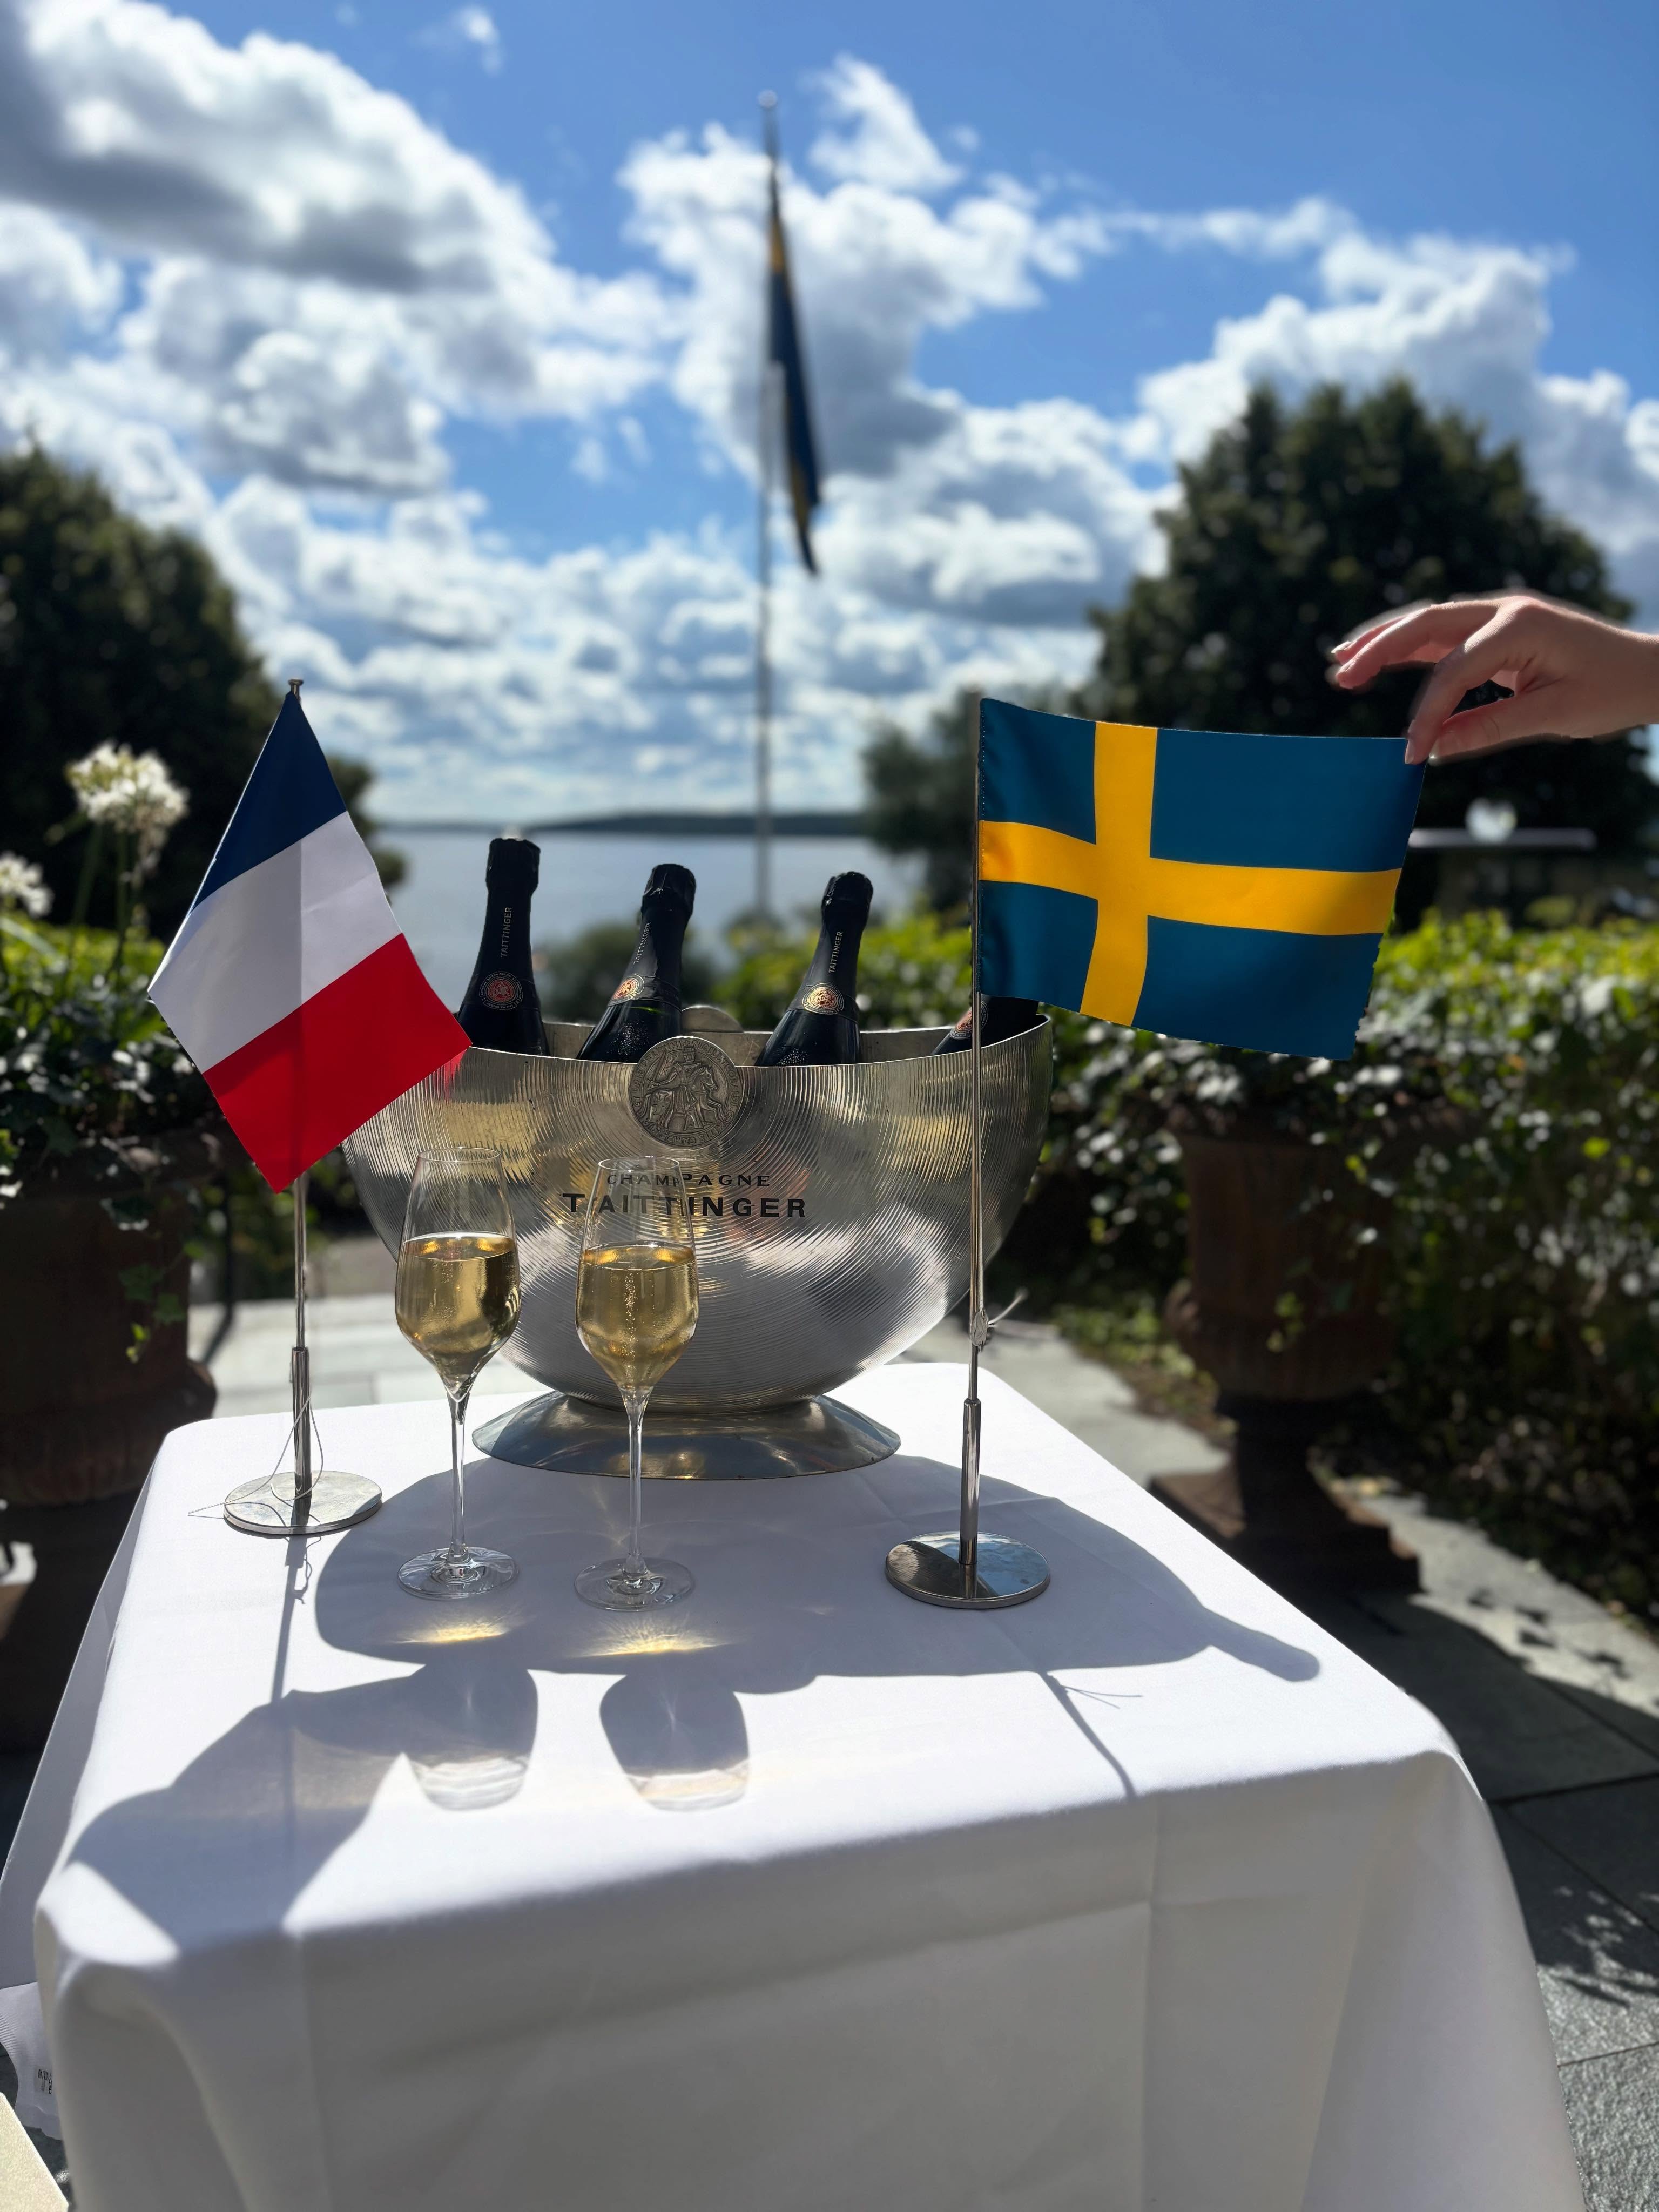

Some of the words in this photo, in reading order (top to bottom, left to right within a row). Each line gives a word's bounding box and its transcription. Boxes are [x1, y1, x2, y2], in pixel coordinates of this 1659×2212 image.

[500, 907, 512, 958] TAITTINGER
[633, 922, 651, 965] TAITTINGER
[828, 931, 844, 973] TAITTINGER
[606, 1173, 770, 1187] CHAMPAGNE
[562, 1193, 806, 1218] TAITTINGER
